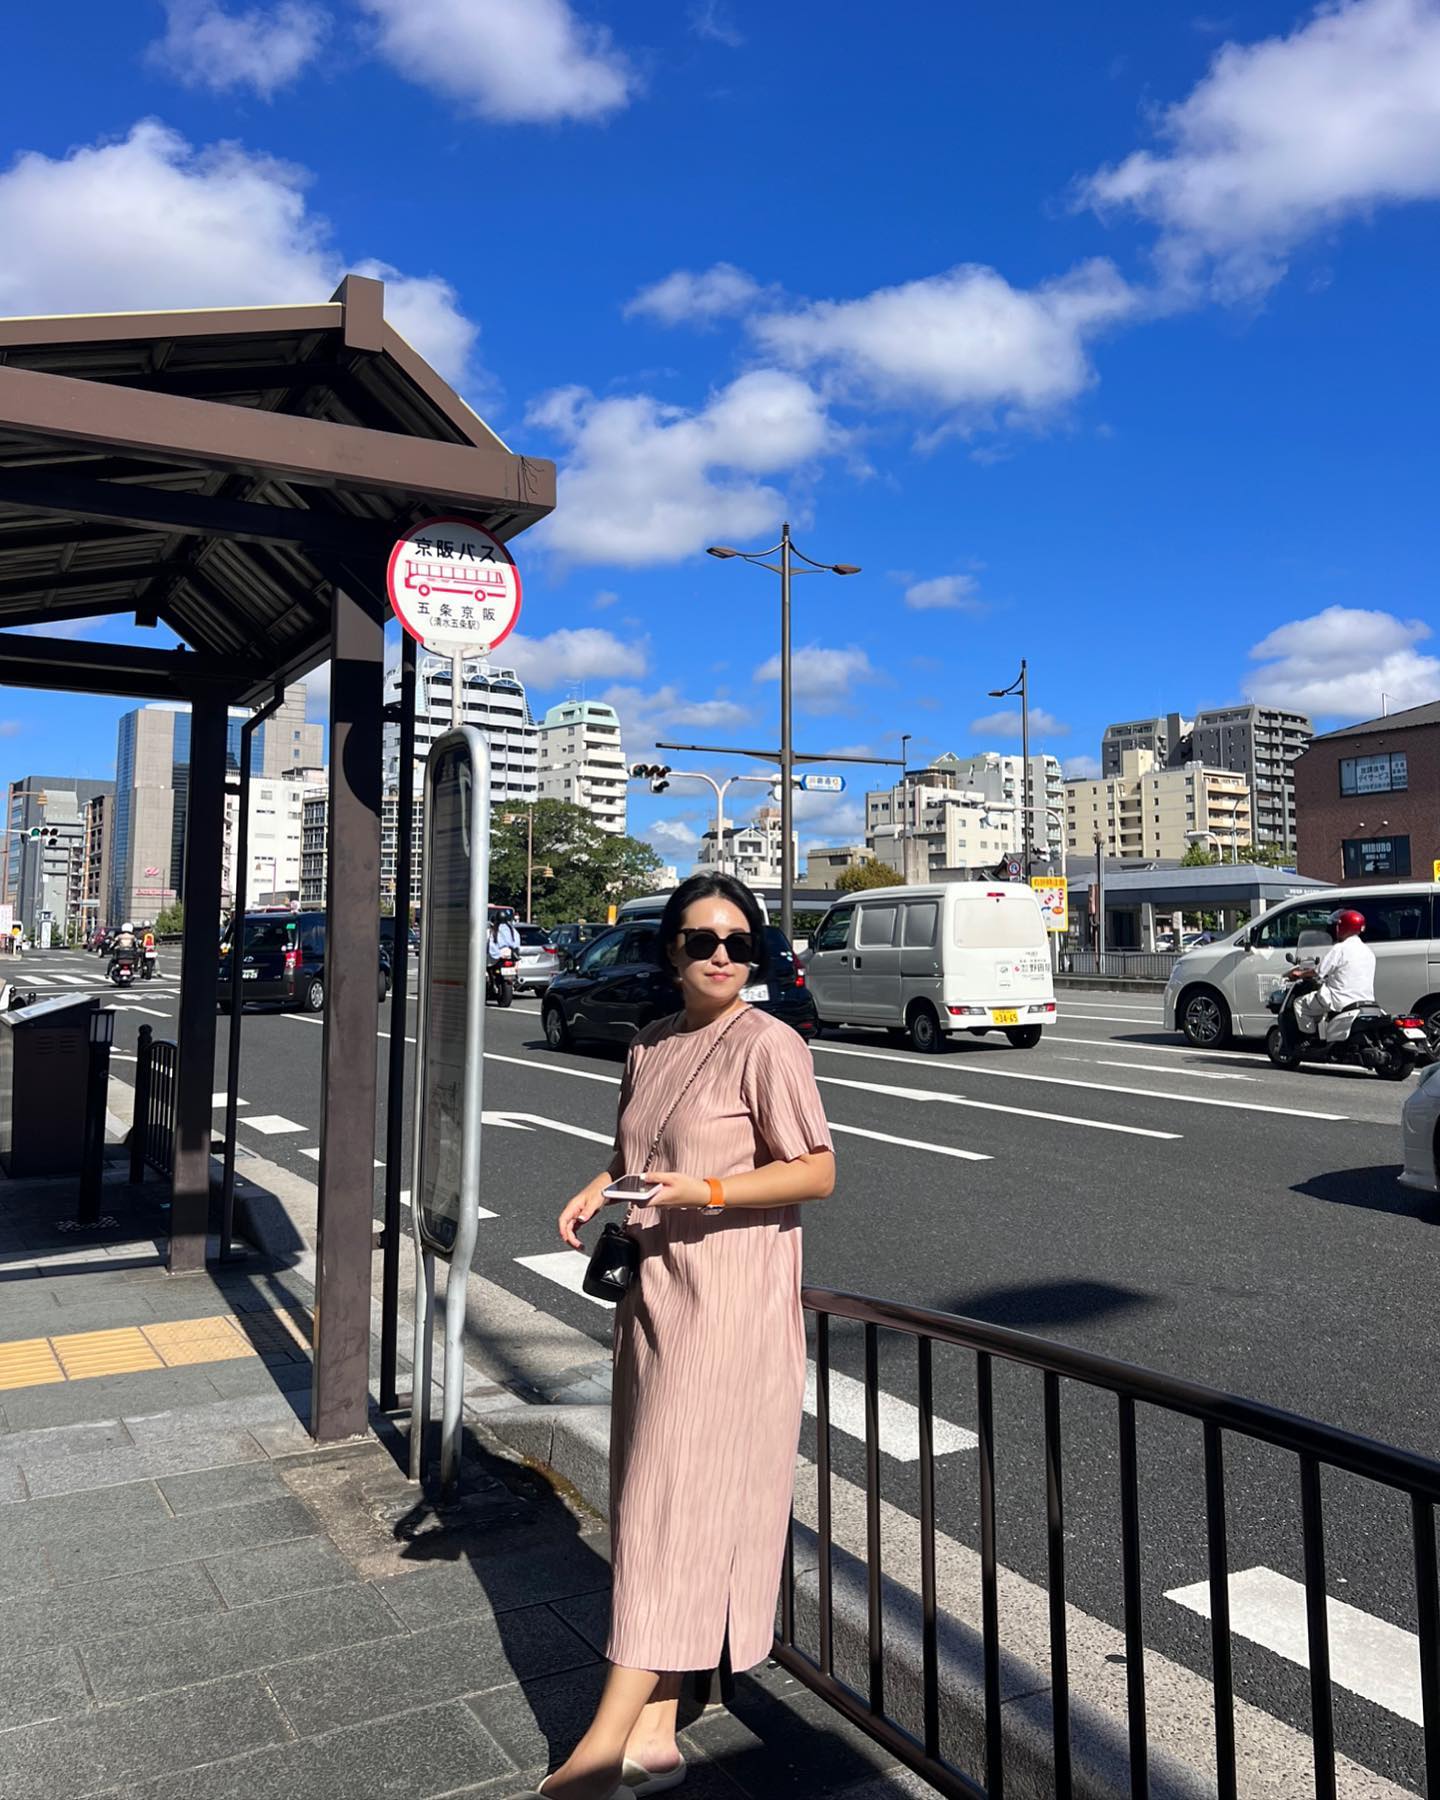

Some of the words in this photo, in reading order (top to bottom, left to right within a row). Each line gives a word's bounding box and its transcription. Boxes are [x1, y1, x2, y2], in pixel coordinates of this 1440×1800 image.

[414, 537, 496, 564] 京阪バス
[417, 601, 496, 621] 五条京阪
